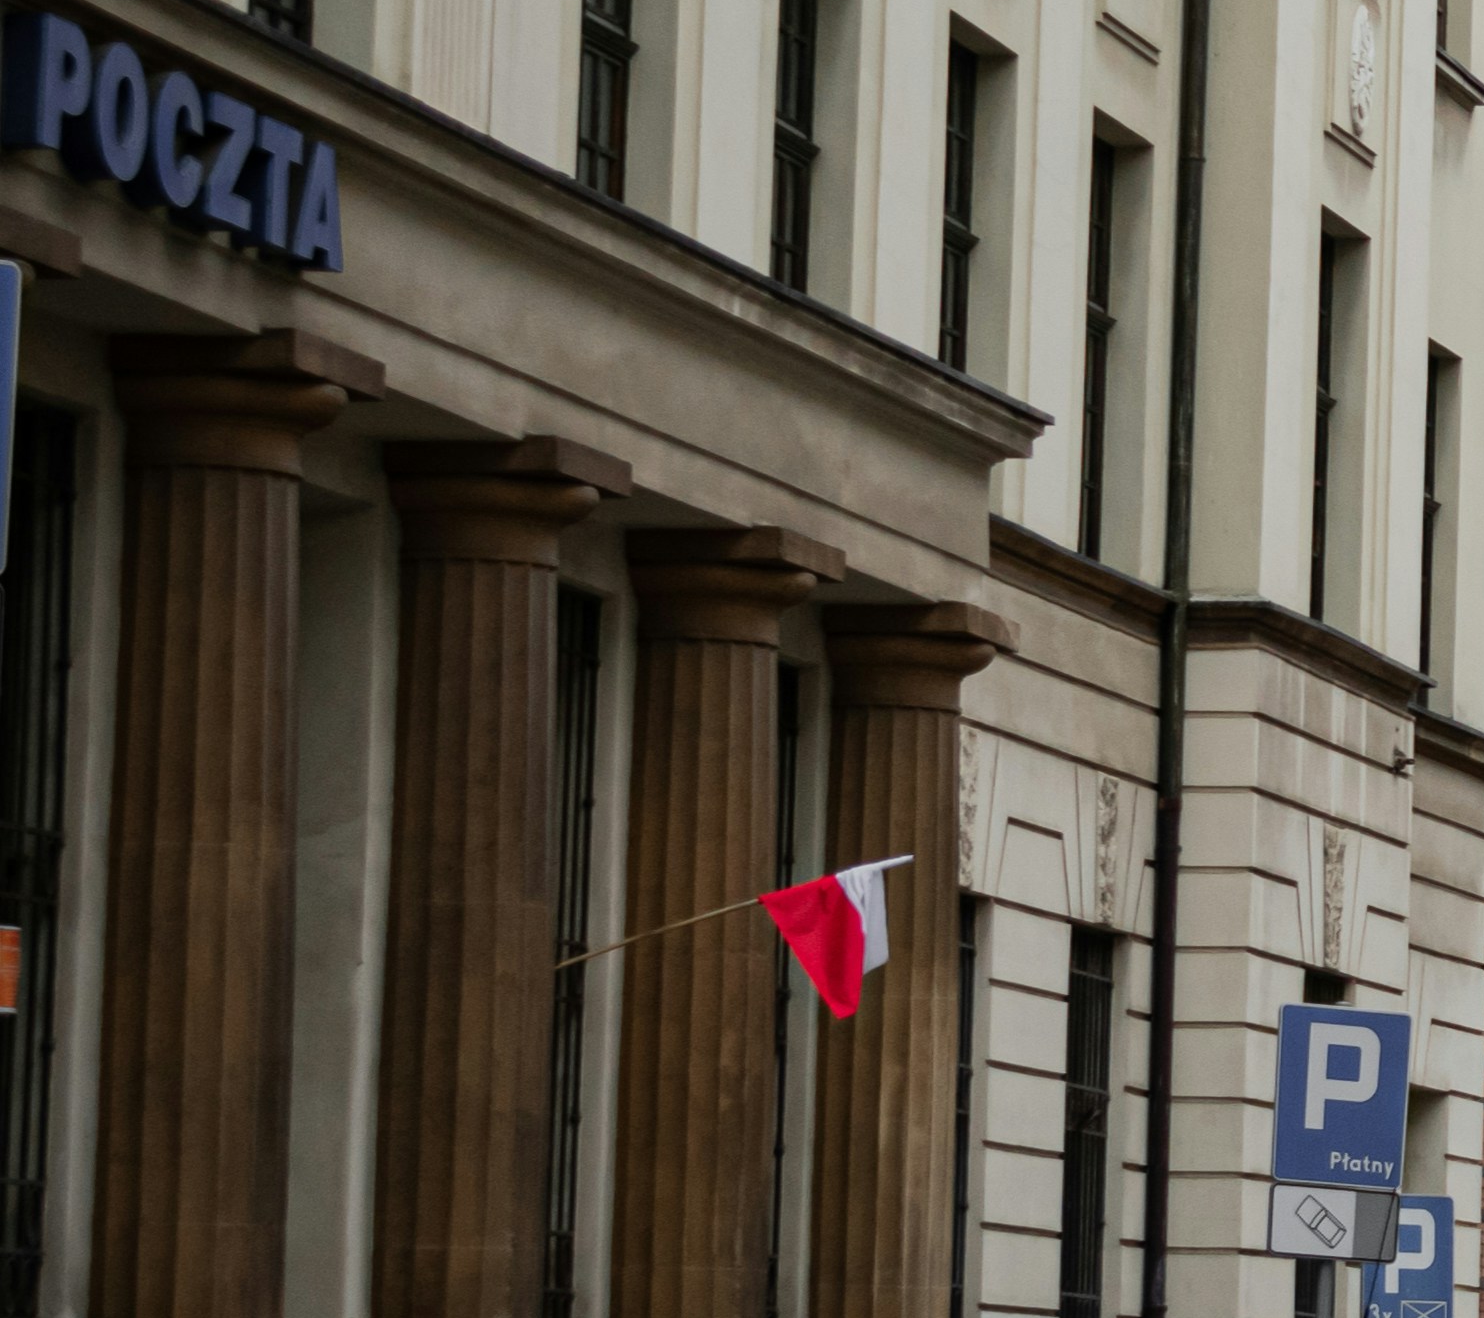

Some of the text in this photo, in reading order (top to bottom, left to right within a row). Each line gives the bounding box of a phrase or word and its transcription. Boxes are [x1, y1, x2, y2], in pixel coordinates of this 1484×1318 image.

[35, 12, 344, 273] POCZTA
[1304, 1021, 1381, 1130] P
[1330, 1151, 1394, 1180] Płatny
[1384, 1207, 1436, 1294] P
